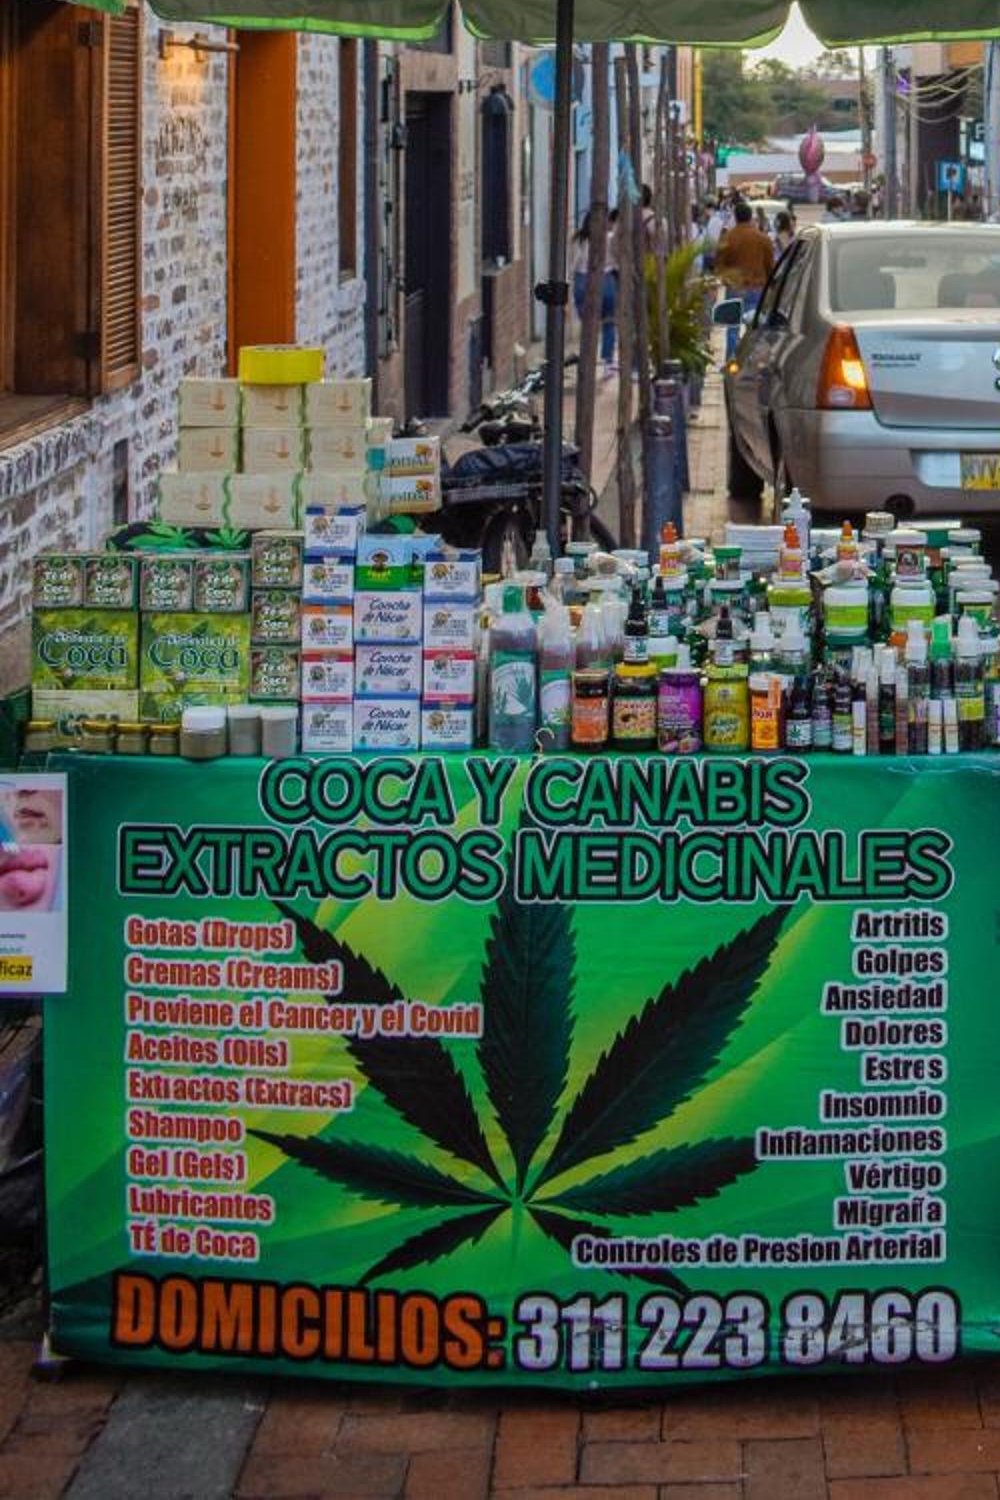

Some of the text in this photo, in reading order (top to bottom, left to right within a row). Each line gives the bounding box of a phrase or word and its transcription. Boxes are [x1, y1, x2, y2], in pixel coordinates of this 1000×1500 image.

[368, 599, 412, 612] Concha
[38, 635, 128, 668] Coca
[147, 636, 239, 669] Coca
[369, 651, 413, 664] Concha
[368, 707, 411, 719] Concha
[260, 755, 811, 828] COCA Y CANABIS
[118, 823, 955, 903] EXTRACTOS MEDICINALES
[126, 916, 294, 951] Gotas (Drops)
[853, 910, 946, 940] Artritis
[126, 956, 342, 992] Cremas (Creams)
[856, 946, 945, 976] Golpes
[822, 983, 945, 1012] Ansiedad
[127, 995, 483, 1036] Previene el Cancer y el Covid
[127, 1032, 288, 1068] Aceites (Oils)
[844, 1019, 945, 1048] Dolores
[863, 1055, 944, 1083] Estres
[128, 1071, 353, 1109] Extractos (Extracs)
[822, 1092, 944, 1121] Insomnio
[128, 1109, 243, 1143] Shampoo
[758, 1128, 944, 1159] Inflamaciones
[128, 1148, 247, 1181] Gel (Gels)
[848, 1162, 944, 1192] Vértigo
[129, 1186, 274, 1222] Lubricantes
[836, 1195, 943, 1227] Migraña
[130, 1221, 258, 1259] TÉ de Coca
[575, 1232, 943, 1265] Controles de Presion Arterial
[112, 1272, 960, 1373] DOMICILIOS: 311 223 8460
